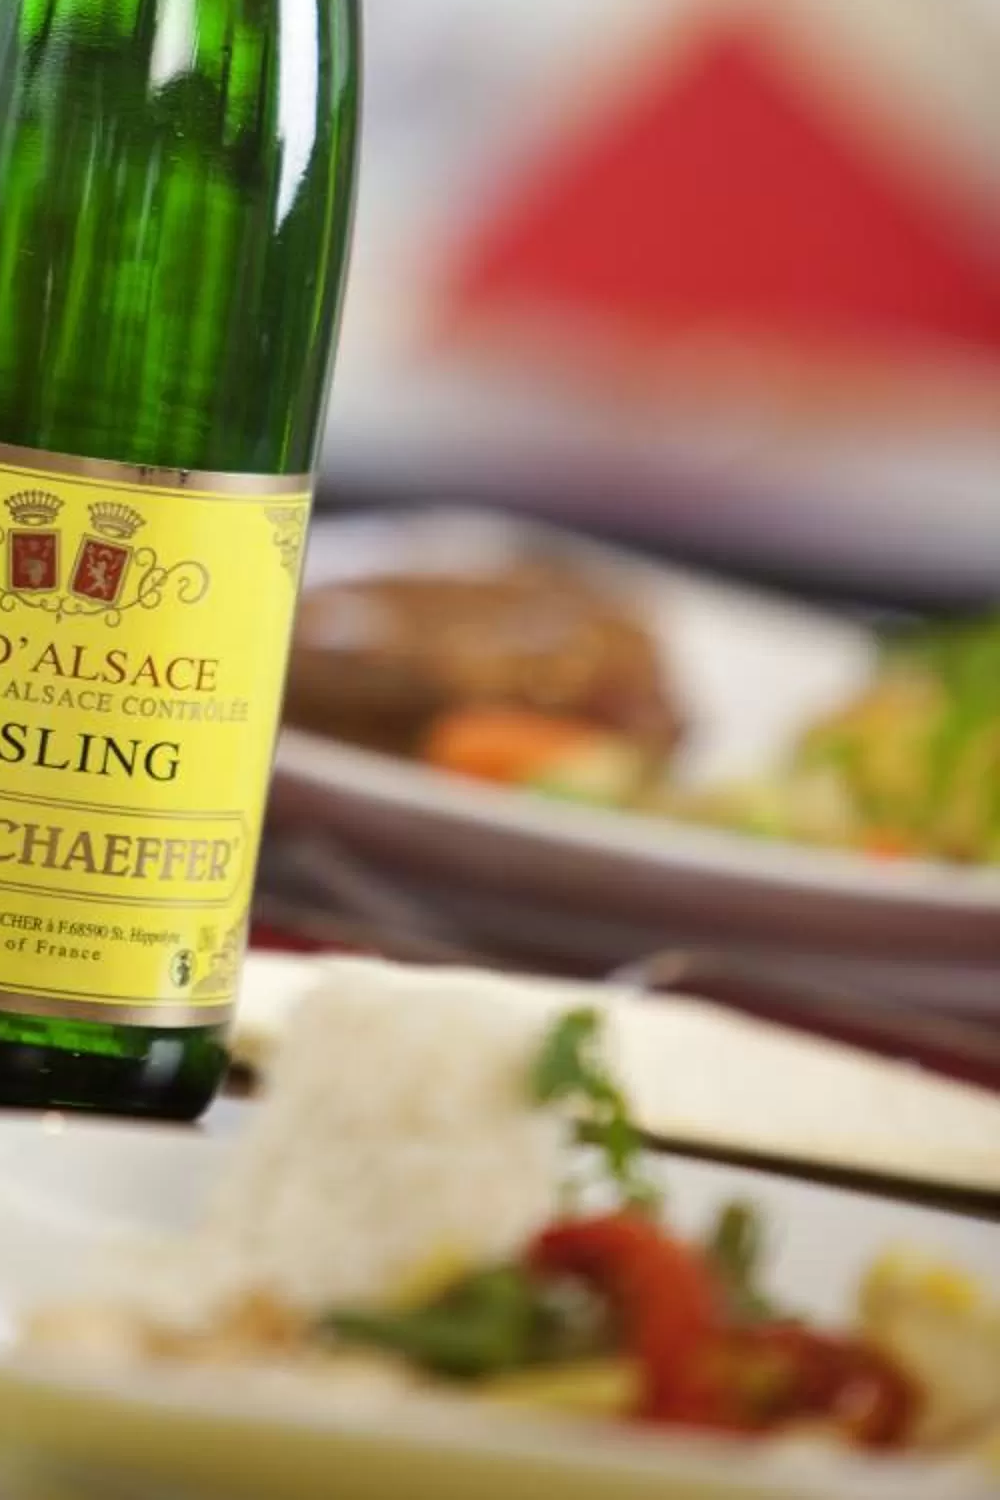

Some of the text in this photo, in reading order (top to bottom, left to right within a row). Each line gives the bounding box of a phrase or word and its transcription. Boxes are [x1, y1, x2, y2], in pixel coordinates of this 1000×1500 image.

[1, 679, 114, 713] ALSACE
[121, 694, 248, 723] CONTRÔLÉE
[4, 937, 26, 950] of
[35, 938, 101, 961] France
